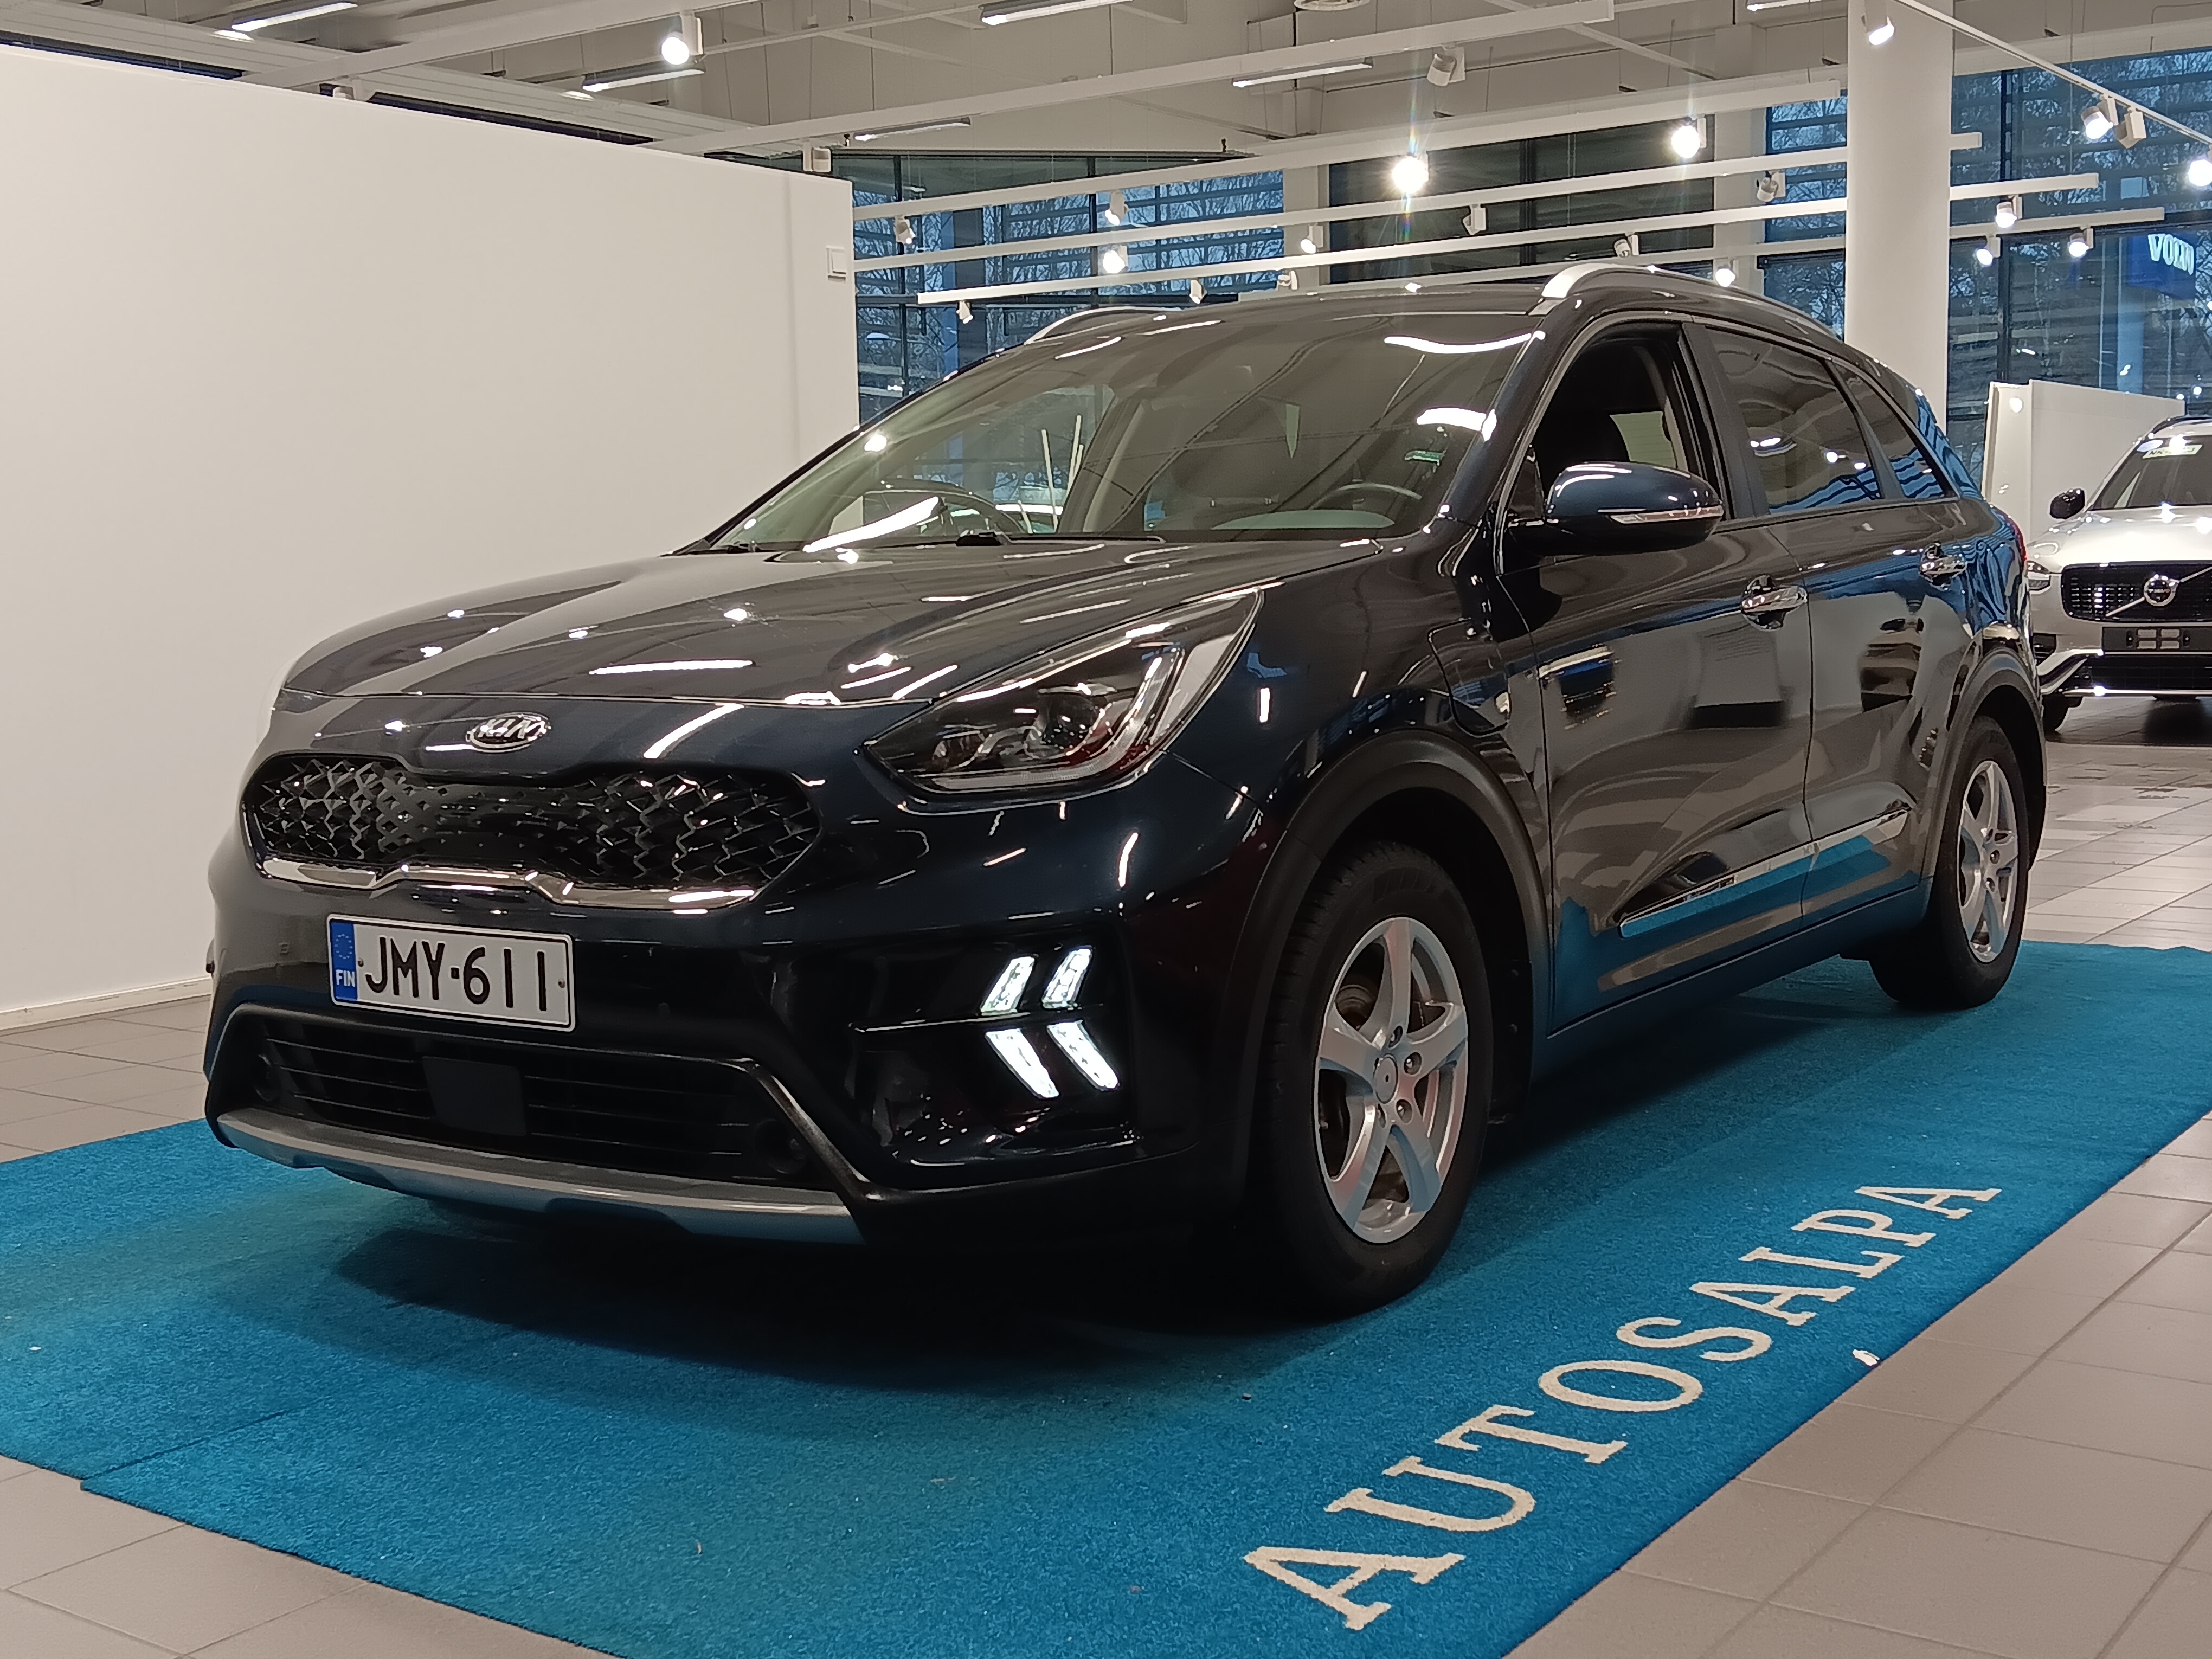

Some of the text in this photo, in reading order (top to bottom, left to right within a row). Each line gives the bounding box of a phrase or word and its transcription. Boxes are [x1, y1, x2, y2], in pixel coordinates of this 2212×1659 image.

[477, 718, 531, 739] KIA
[336, 969, 355, 987] FIN
[365, 936, 547, 1012] JMY-611
[1244, 1186, 2002, 1630] AUTOSALPA
